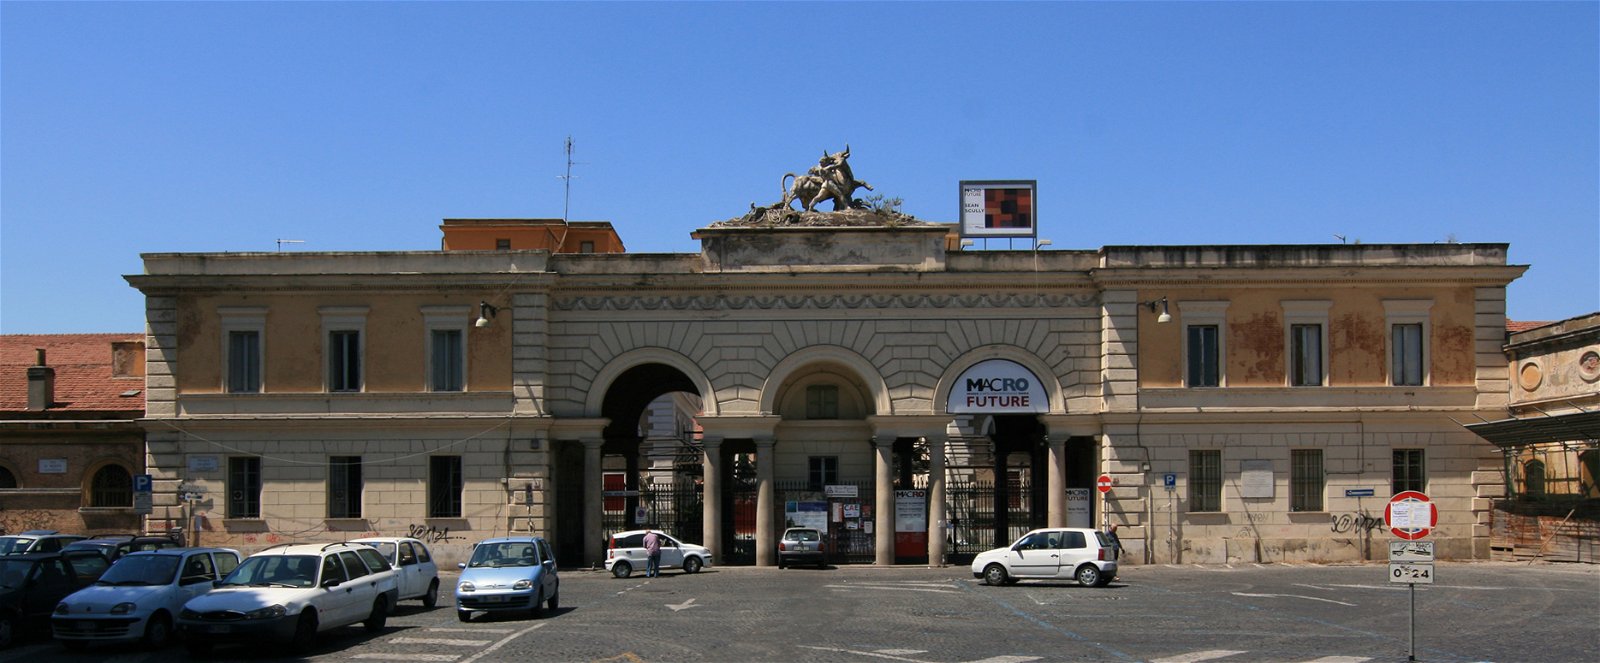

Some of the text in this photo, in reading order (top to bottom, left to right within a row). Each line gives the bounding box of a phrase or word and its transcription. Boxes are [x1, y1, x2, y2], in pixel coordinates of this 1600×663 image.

[966, 378, 1029, 392] MACRO
[966, 396, 1029, 407] FUTURE
[137, 477, 148, 490] P
[1166, 475, 1174, 485] P
